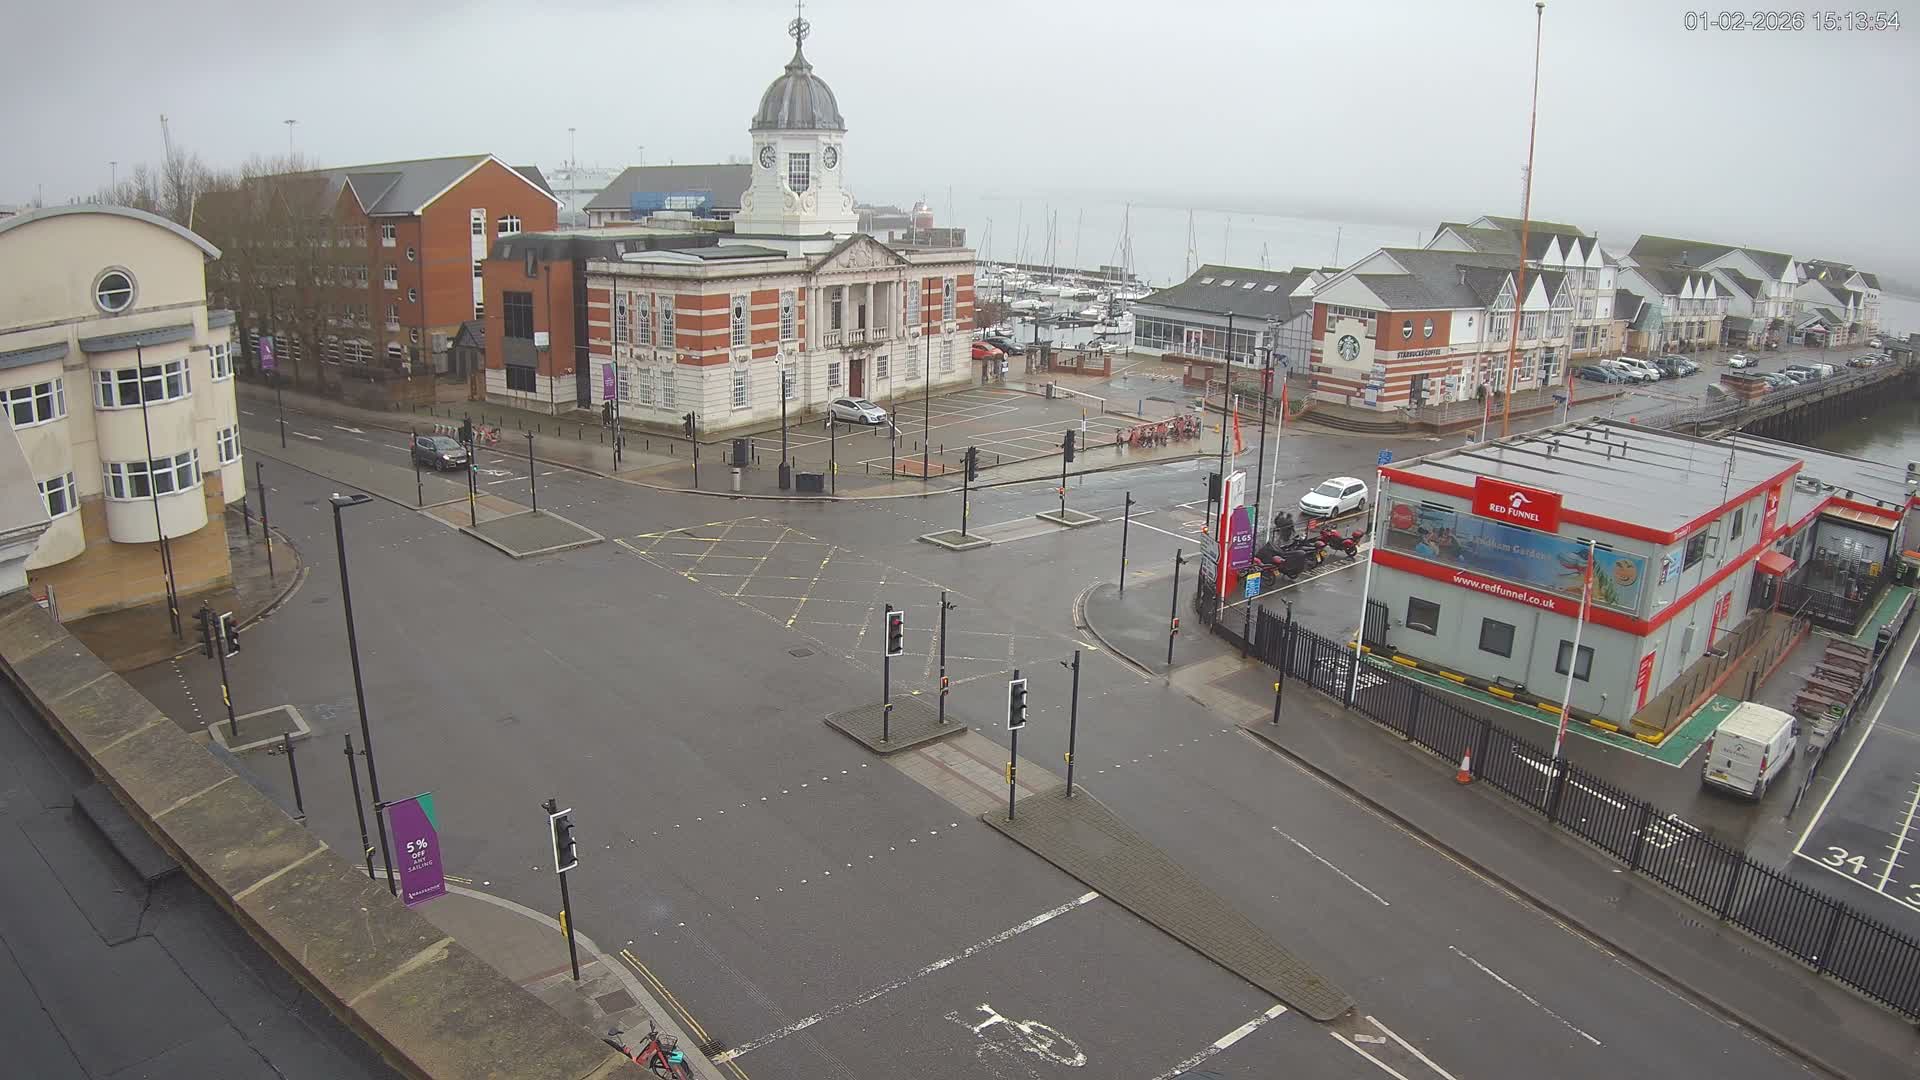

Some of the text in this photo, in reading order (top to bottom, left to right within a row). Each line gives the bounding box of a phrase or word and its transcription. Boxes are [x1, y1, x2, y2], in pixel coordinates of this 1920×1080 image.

[1397, 348, 1441, 359] STARBUCKS COFFEE
[1489, 503, 1540, 522] RED FUNNEL
[1453, 574, 1556, 609] www.redfunnel.co.uk
[411, 850, 425, 859] OFF
[413, 857, 426, 865] ANY
[1821, 846, 1868, 875] 34
[408, 860, 433, 873] SAILING
